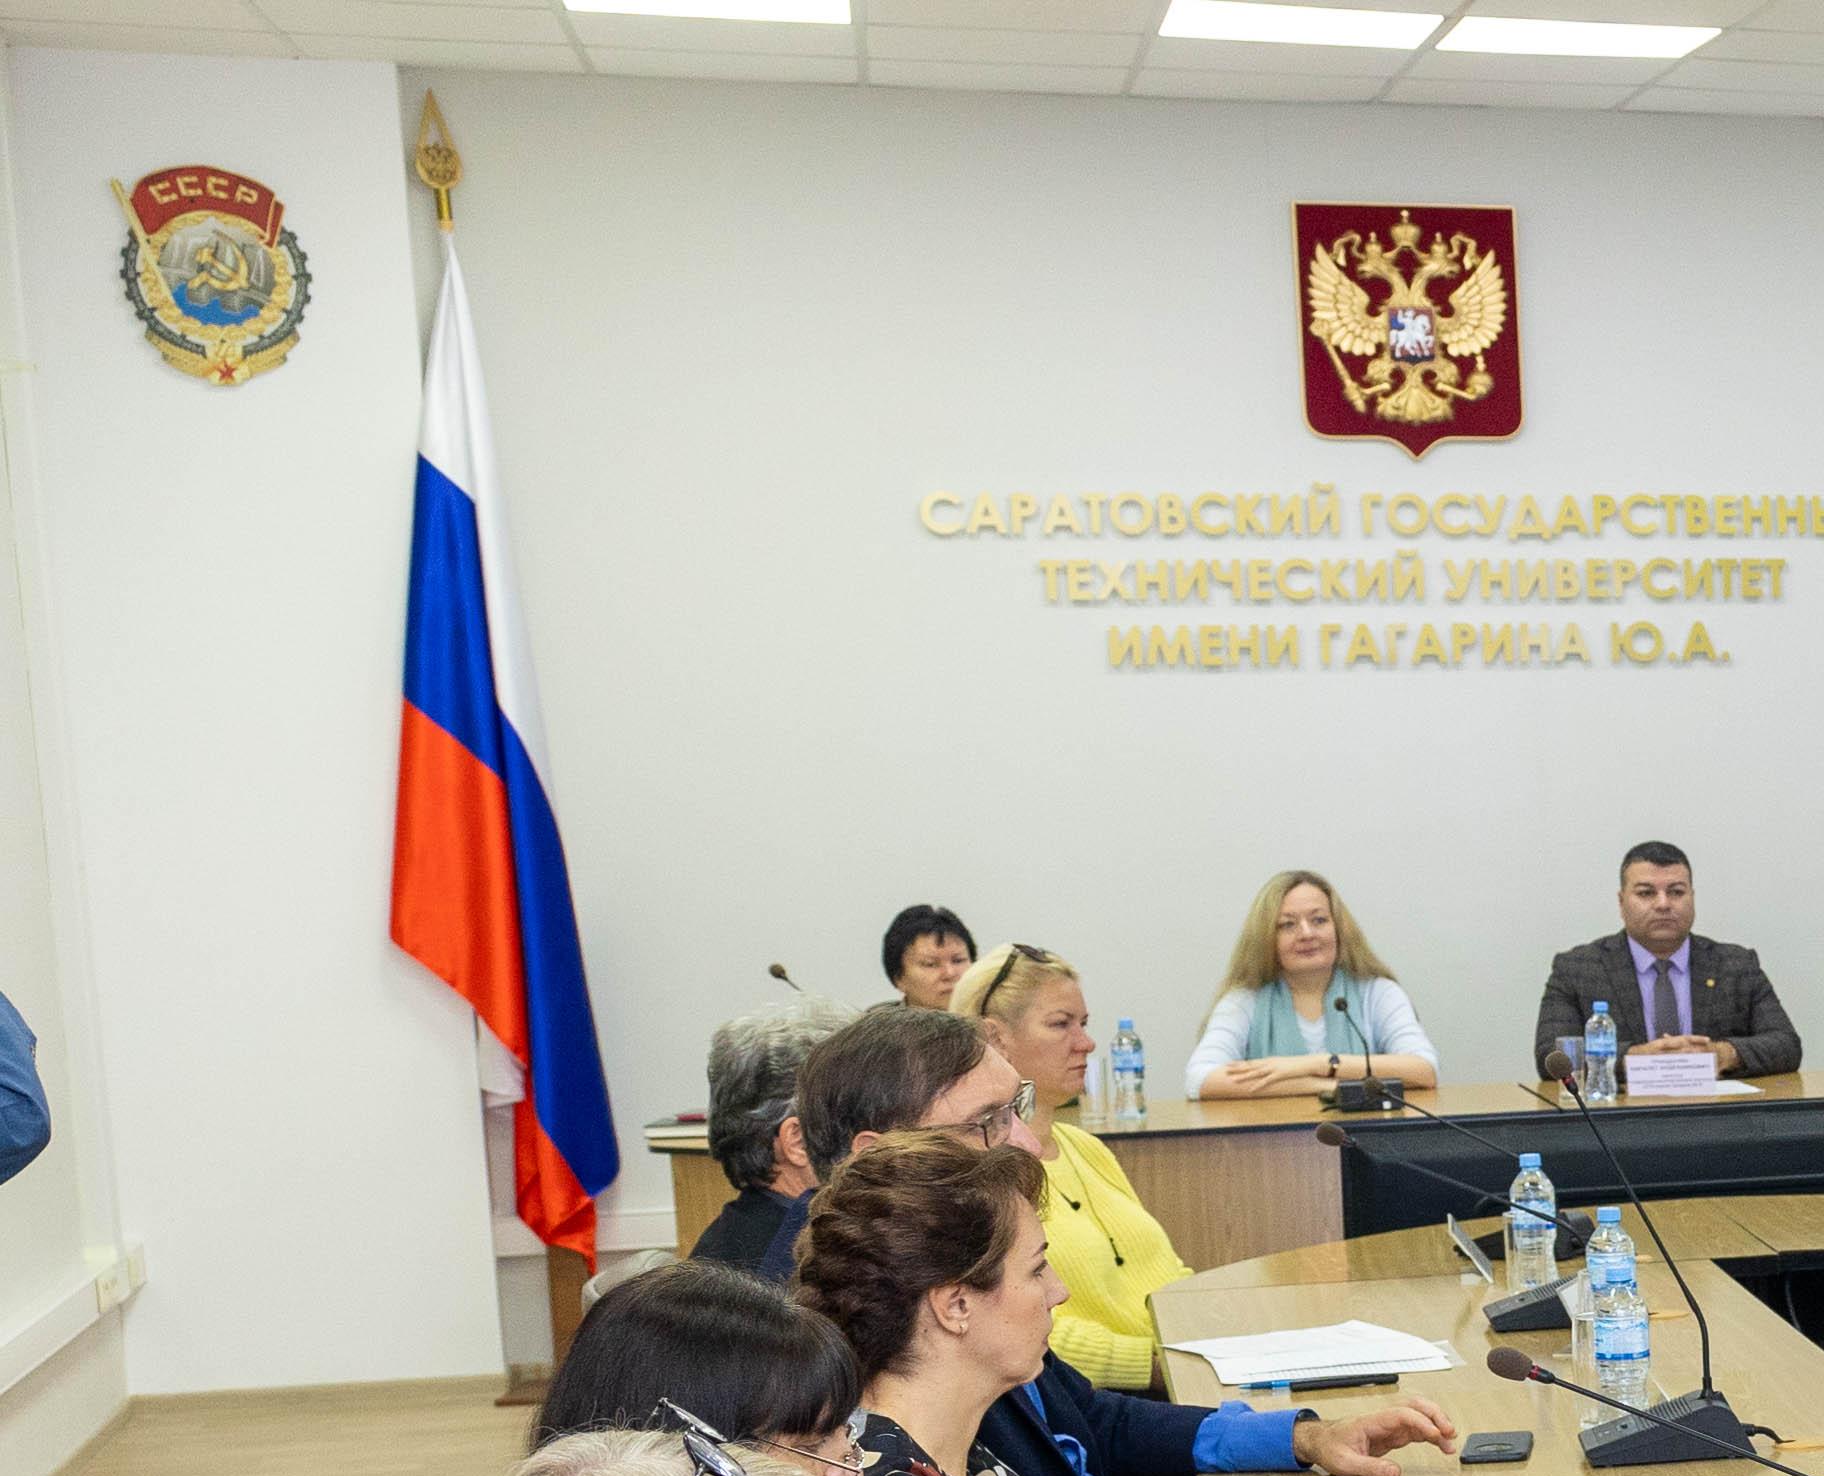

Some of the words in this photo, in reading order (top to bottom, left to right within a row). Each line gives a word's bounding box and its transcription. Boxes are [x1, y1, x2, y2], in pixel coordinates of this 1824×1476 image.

[149, 175, 259, 205] СССР
[919, 482, 1342, 537] САРАТОВСКИЙ
[1040, 549, 1425, 602] ТЕХНИЧЕСКИЙ
[1443, 556, 1786, 601] УНИВЕРСИТЕТ
[1108, 623, 1300, 667] ИМЕНИ
[1320, 621, 1591, 666] ГАГАРИНА
[1610, 619, 1731, 665] Ю.А.
